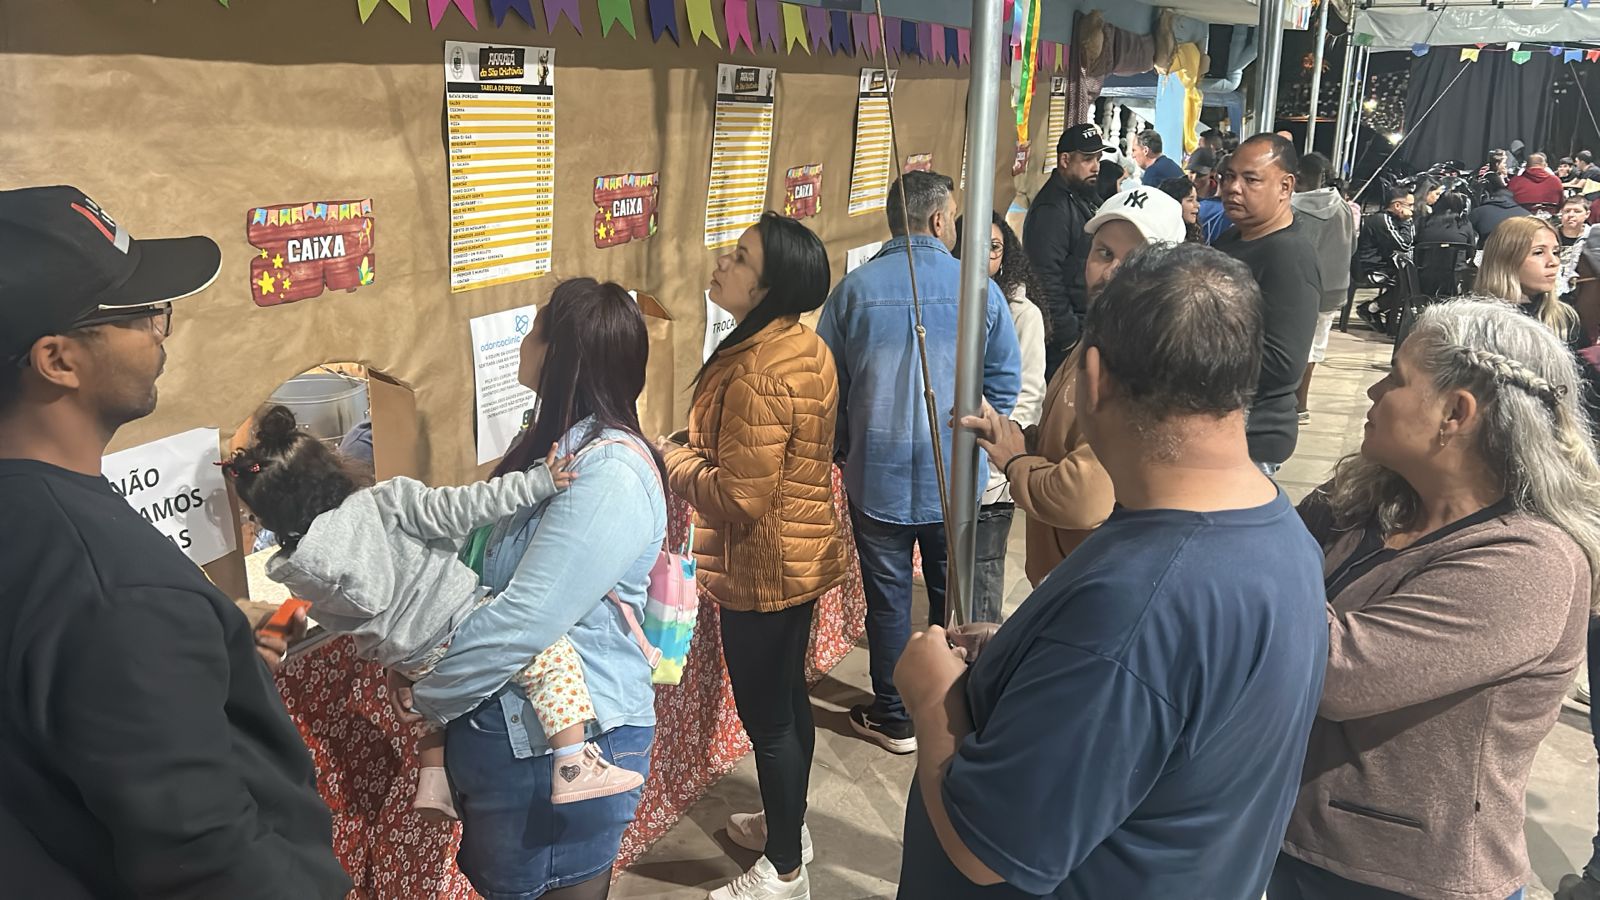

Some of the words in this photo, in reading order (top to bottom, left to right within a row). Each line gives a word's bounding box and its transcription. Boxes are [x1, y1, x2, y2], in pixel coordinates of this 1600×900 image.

[505, 85, 522, 93] PREÇOS
[480, 335, 521, 352] odontoclinic
[109, 468, 160, 497] NÃO
[139, 488, 203, 523] AMOS
